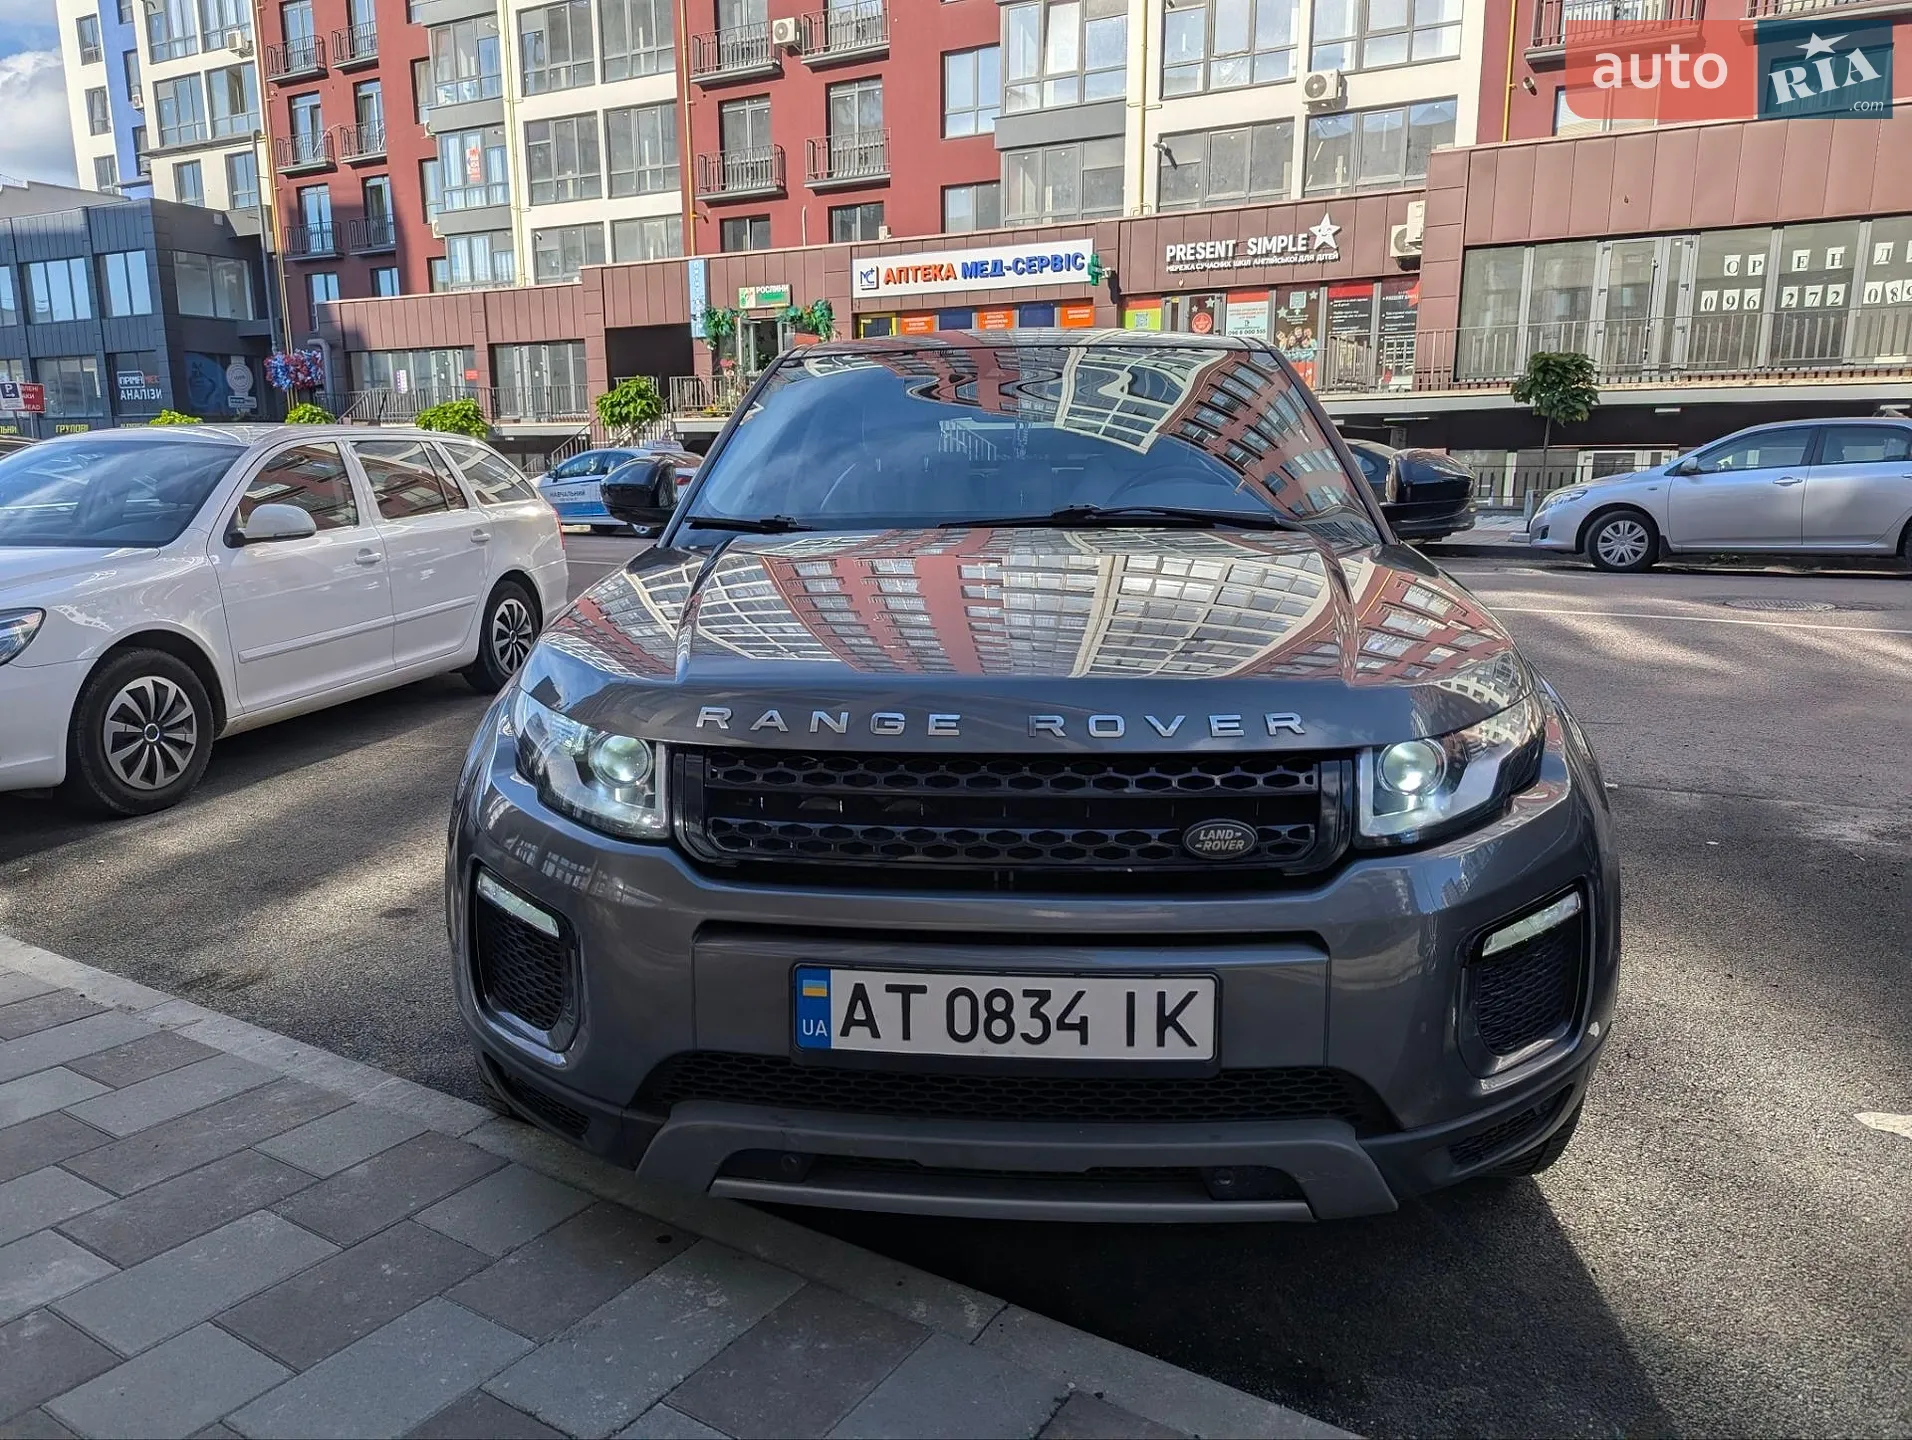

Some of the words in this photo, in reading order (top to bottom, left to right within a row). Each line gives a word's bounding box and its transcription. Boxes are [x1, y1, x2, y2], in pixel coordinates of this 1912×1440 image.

[1166, 239, 1237, 262] PRESENT
[1247, 233, 1309, 256] SIMPLE
[1726, 247, 1912, 274] ОРЕНД
[883, 262, 957, 286] АПТЕКА
[961, 252, 1085, 280] МЕД-СЕРВІС
[755, 284, 790, 294] РОСЛИНИ
[1704, 293, 1757, 310] 096
[1785, 290, 1841, 308] 272
[120, 388, 163, 401] АНАЛІЗИ
[695, 706, 962, 737] RANGE
[1028, 711, 1306, 738] ROVER
[802, 1019, 828, 1038] UA
[839, 982, 928, 1041] AT
[945, 986, 1090, 1047] 0834
[1125, 990, 1199, 1048] IK
